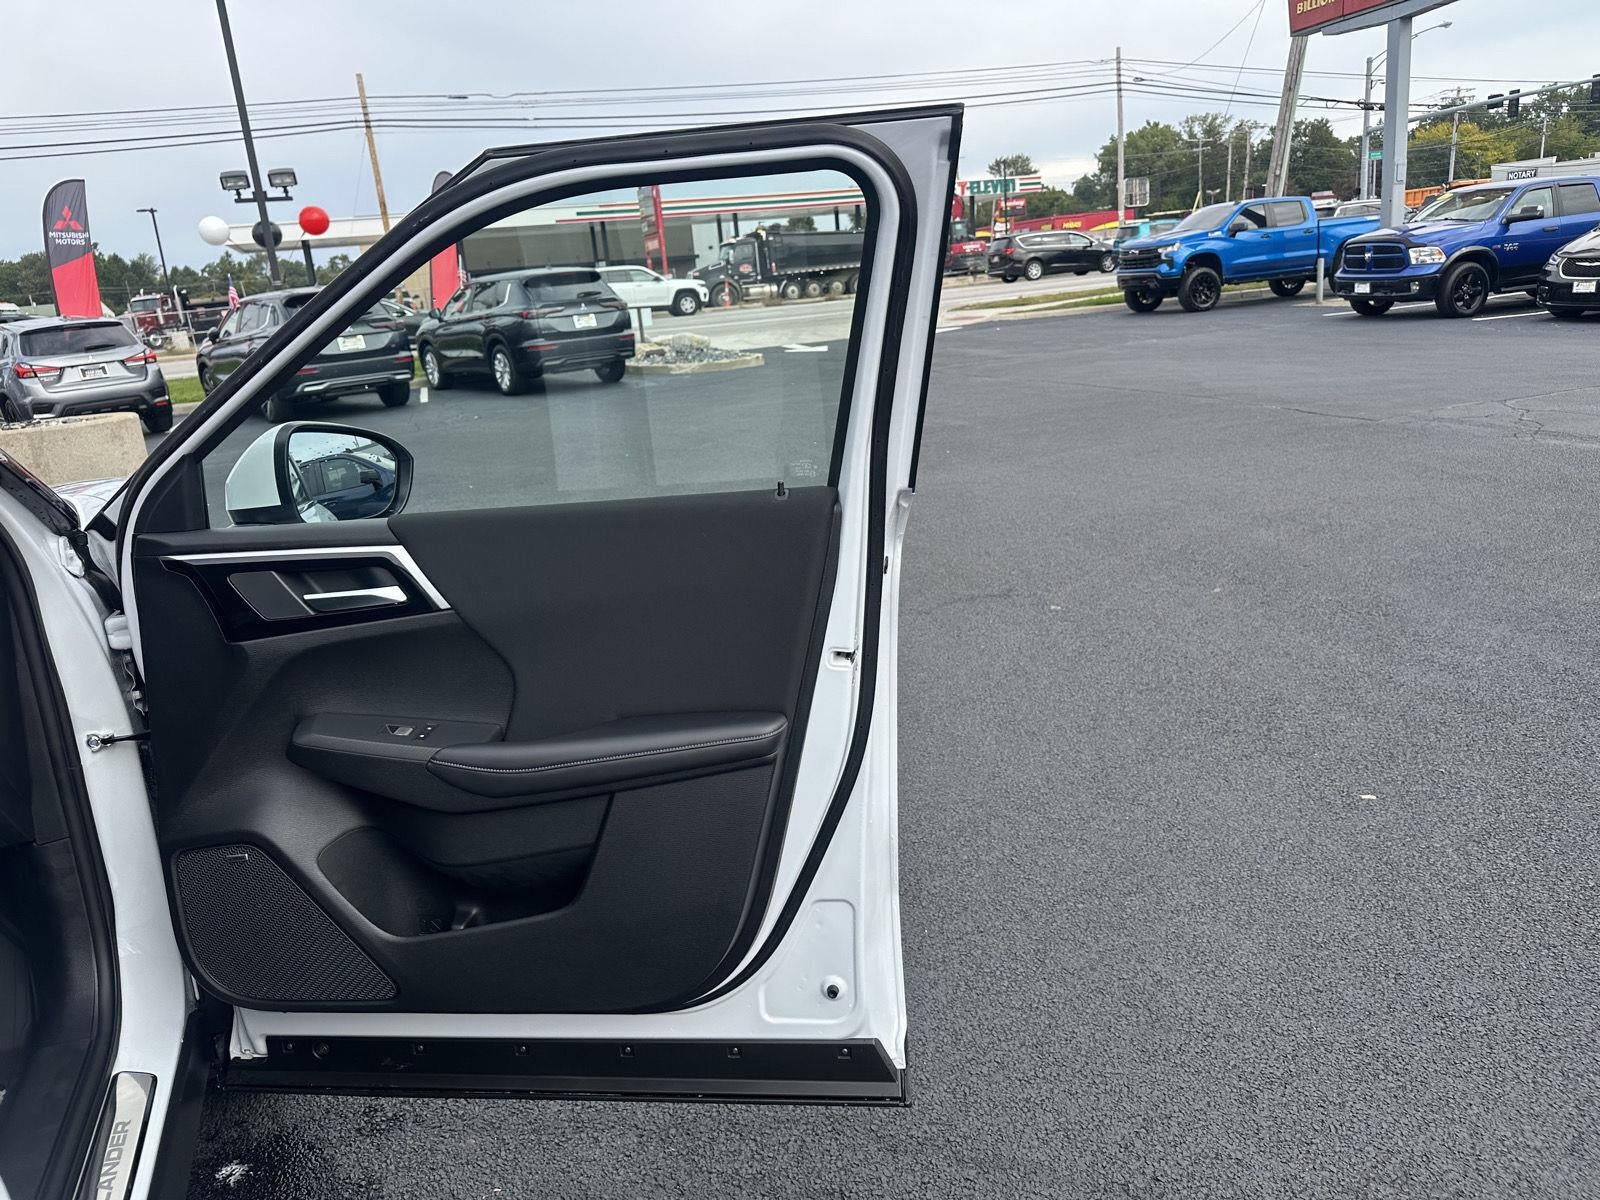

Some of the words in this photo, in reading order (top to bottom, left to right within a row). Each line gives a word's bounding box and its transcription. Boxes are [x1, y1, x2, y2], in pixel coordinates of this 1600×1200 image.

[1297, 0, 1335, 14] BILLIO
[1508, 169, 1536, 180] NOTARY
[49, 231, 90, 239] MITSUBISHI
[55, 238, 86, 246] MOTORS
